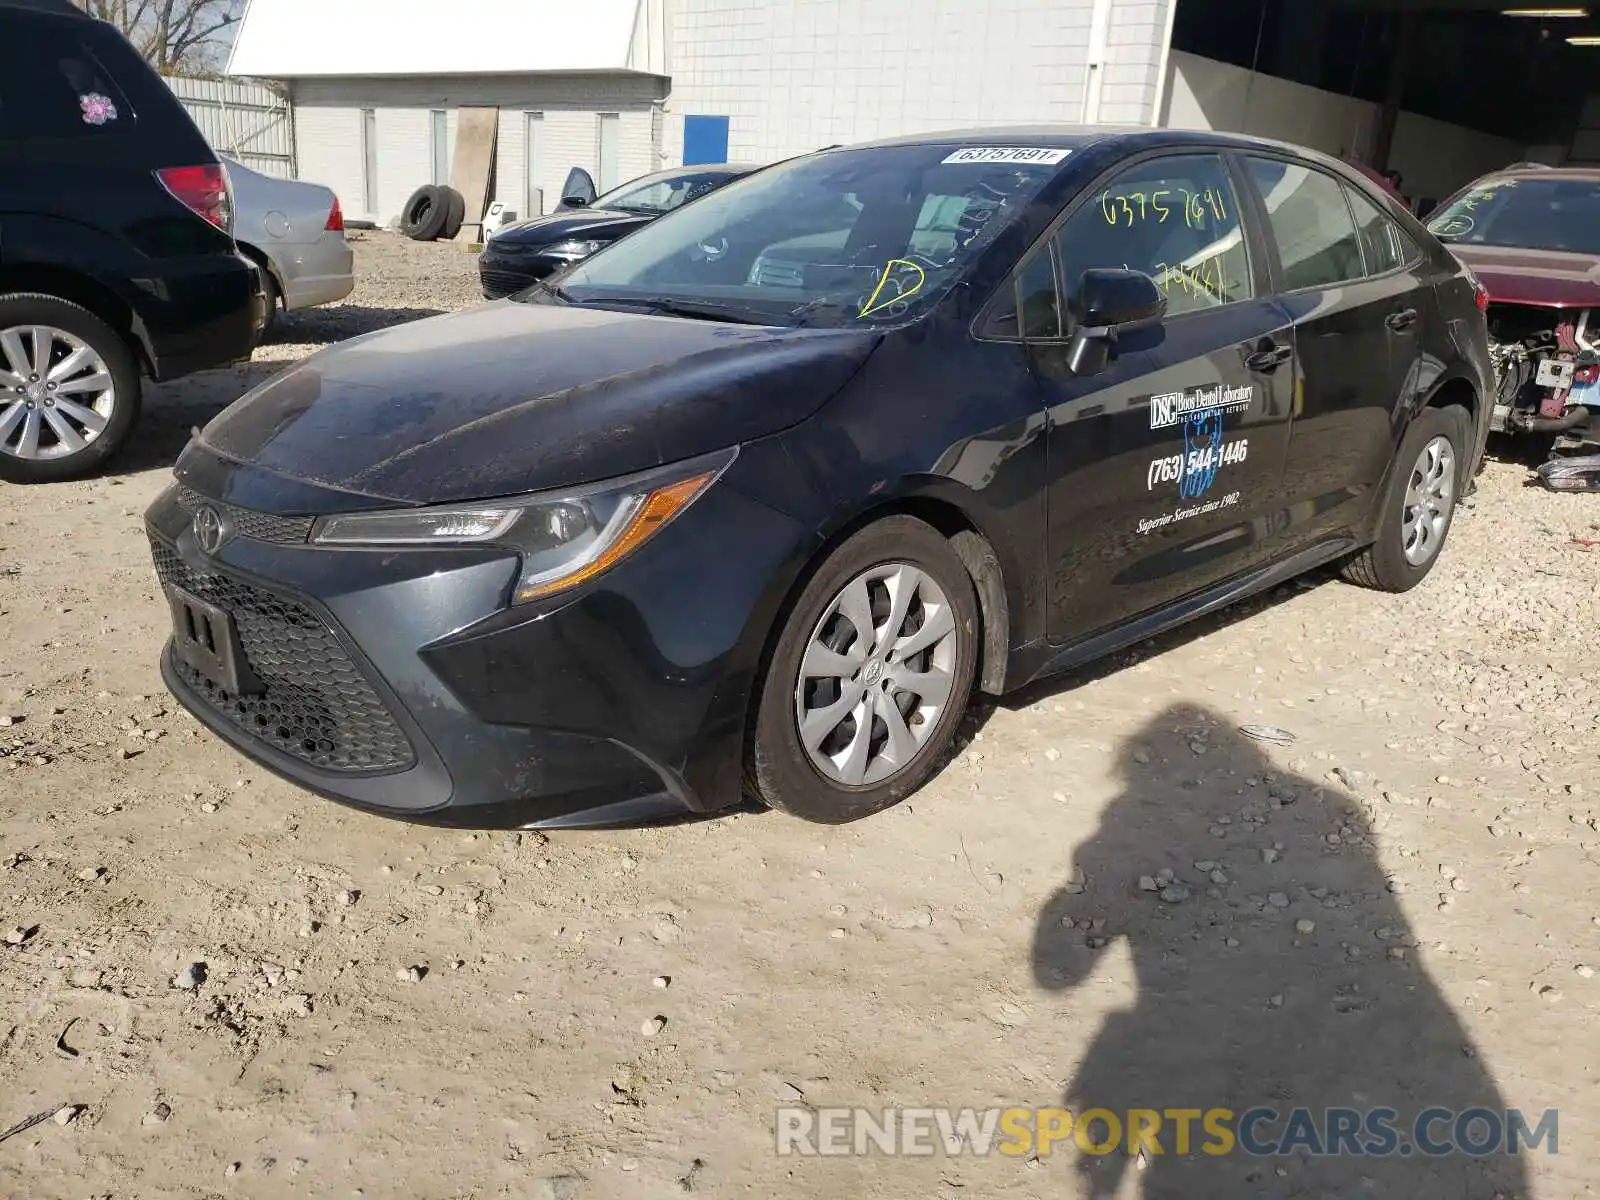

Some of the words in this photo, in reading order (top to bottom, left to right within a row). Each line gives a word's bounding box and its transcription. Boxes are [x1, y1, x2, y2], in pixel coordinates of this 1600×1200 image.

[1195, 387, 1218, 407] Dental
[1219, 384, 1252, 403] Laboratory
[1148, 455, 1183, 490] (763)
[1187, 440, 1247, 474] 544-1446
[1137, 514, 1172, 534] Superior
[1172, 507, 1200, 521] Service
[1200, 500, 1220, 513] since
